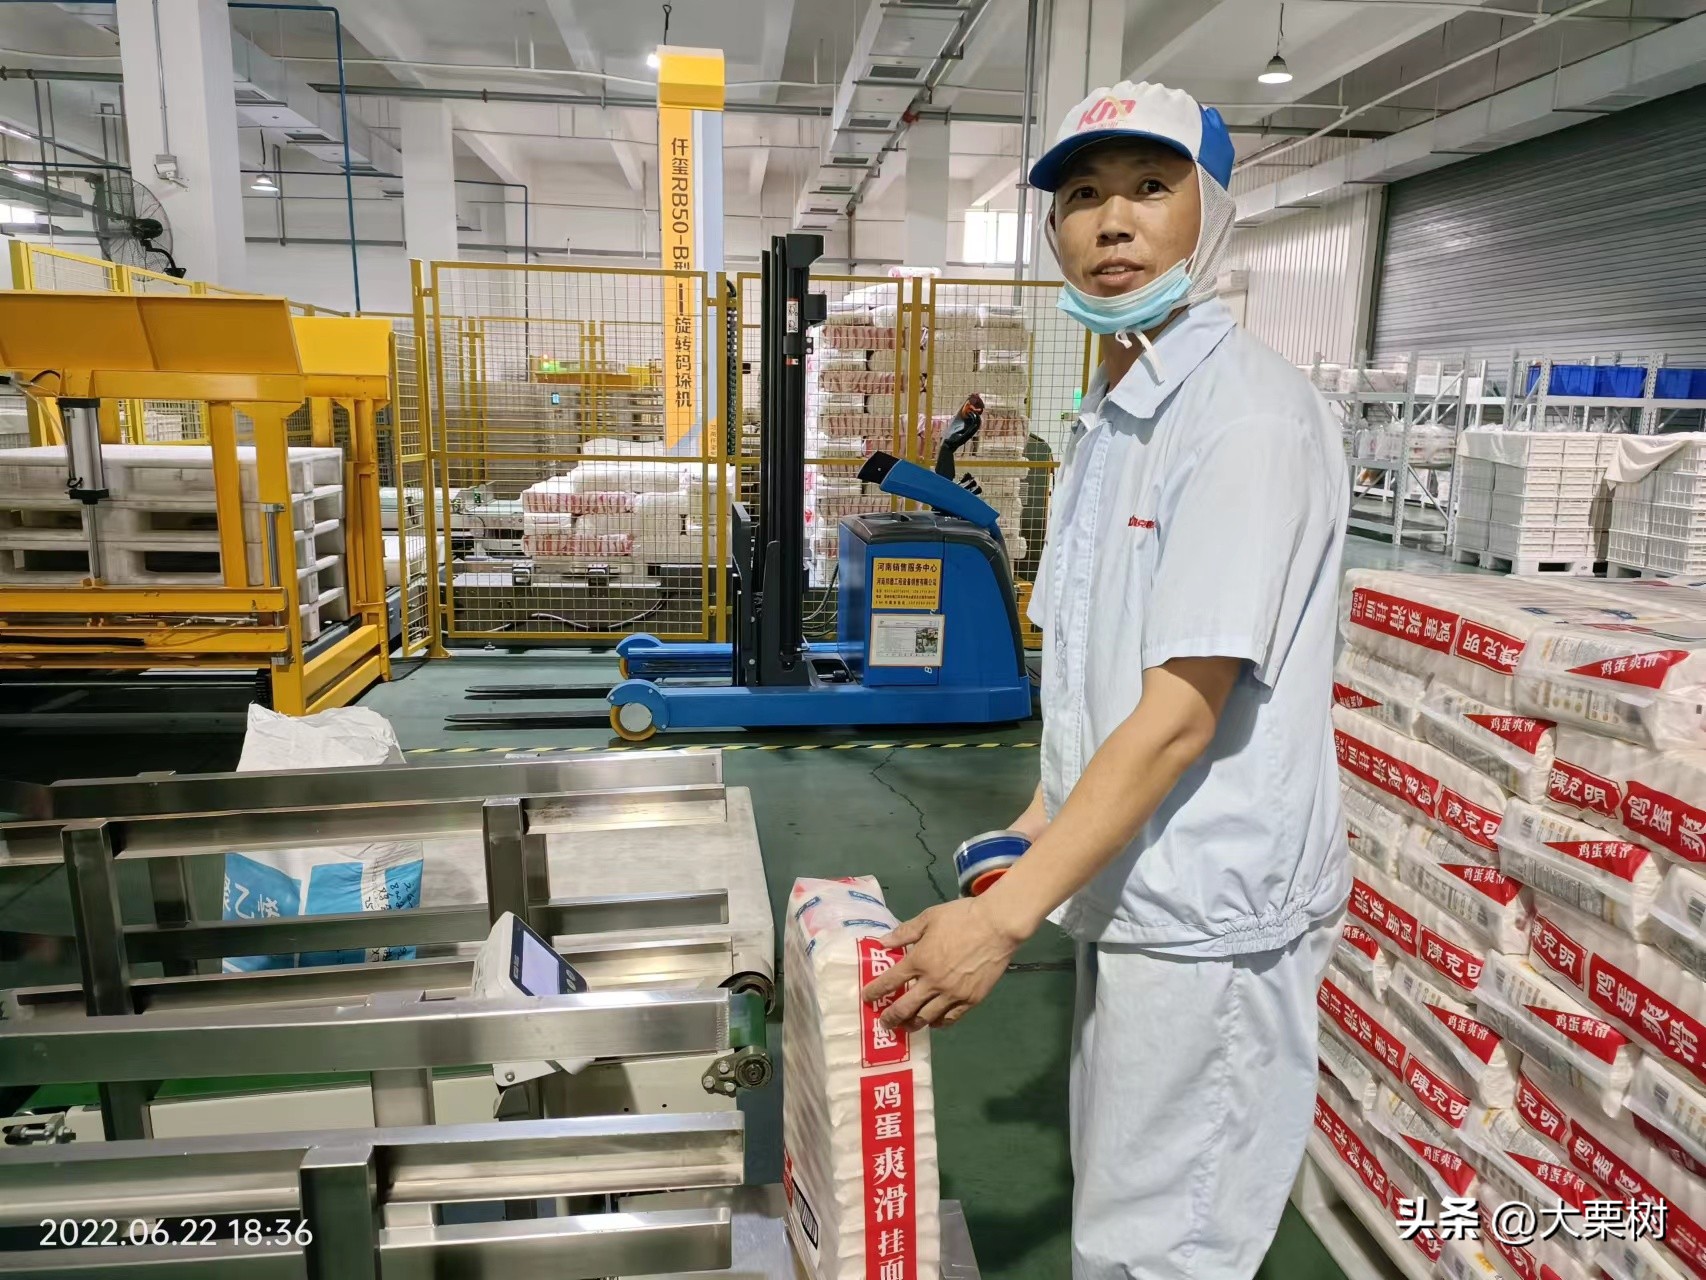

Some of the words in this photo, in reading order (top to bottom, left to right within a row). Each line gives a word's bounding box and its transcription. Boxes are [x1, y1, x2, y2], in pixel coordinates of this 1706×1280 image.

[877, 562, 938, 573] 河南销售服务中心
[1364, 600, 1452, 643] 鸡蛋爽滑挂面
[1489, 716, 1536, 733] 鸡蛋爽滑
[1578, 842, 1634, 860] 鸡蛋爽滑
[1447, 1014, 1489, 1041] 鸡蛋爽滑
[1555, 1013, 1611, 1039] 鸡蛋爽滑
[1596, 970, 1699, 1065] 鸡蛋爽滑
[872, 1081, 908, 1280] 鸡蛋爽滑挂面
